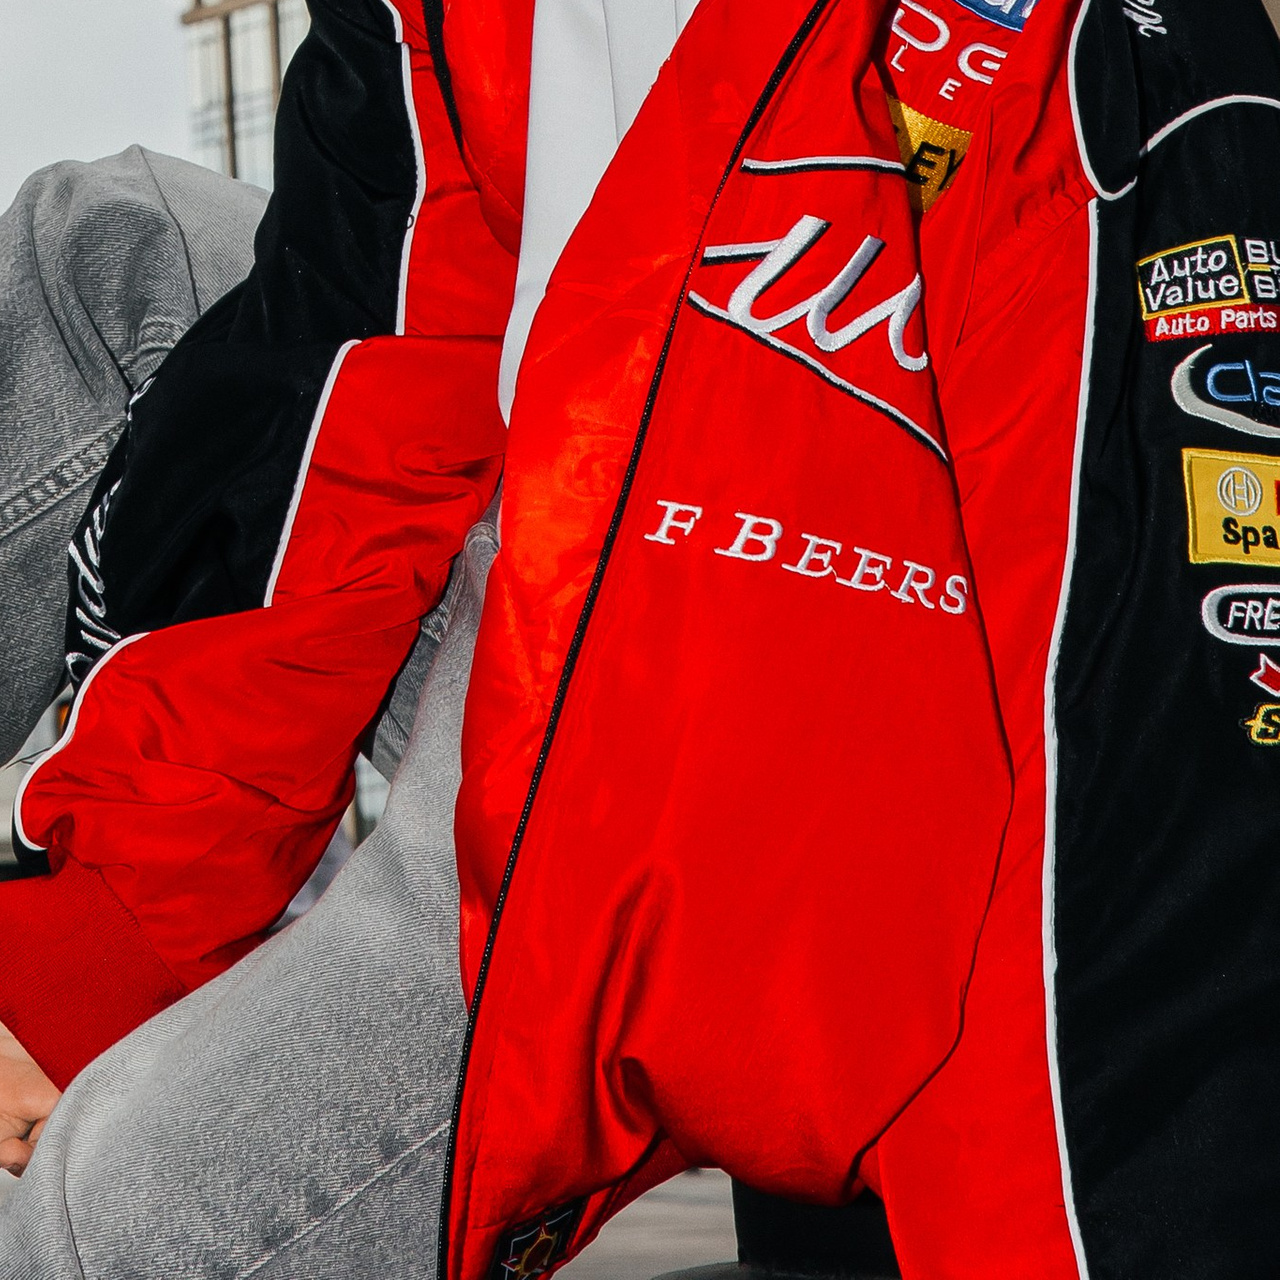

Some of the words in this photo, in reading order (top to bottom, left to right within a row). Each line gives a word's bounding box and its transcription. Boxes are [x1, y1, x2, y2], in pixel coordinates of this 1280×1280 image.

[1150, 246, 1228, 286] Auto
[1145, 274, 1239, 311] Value
[1154, 313, 1210, 337] Auto
[1220, 306, 1277, 330] Parts
[713, 510, 968, 615] BEERS
